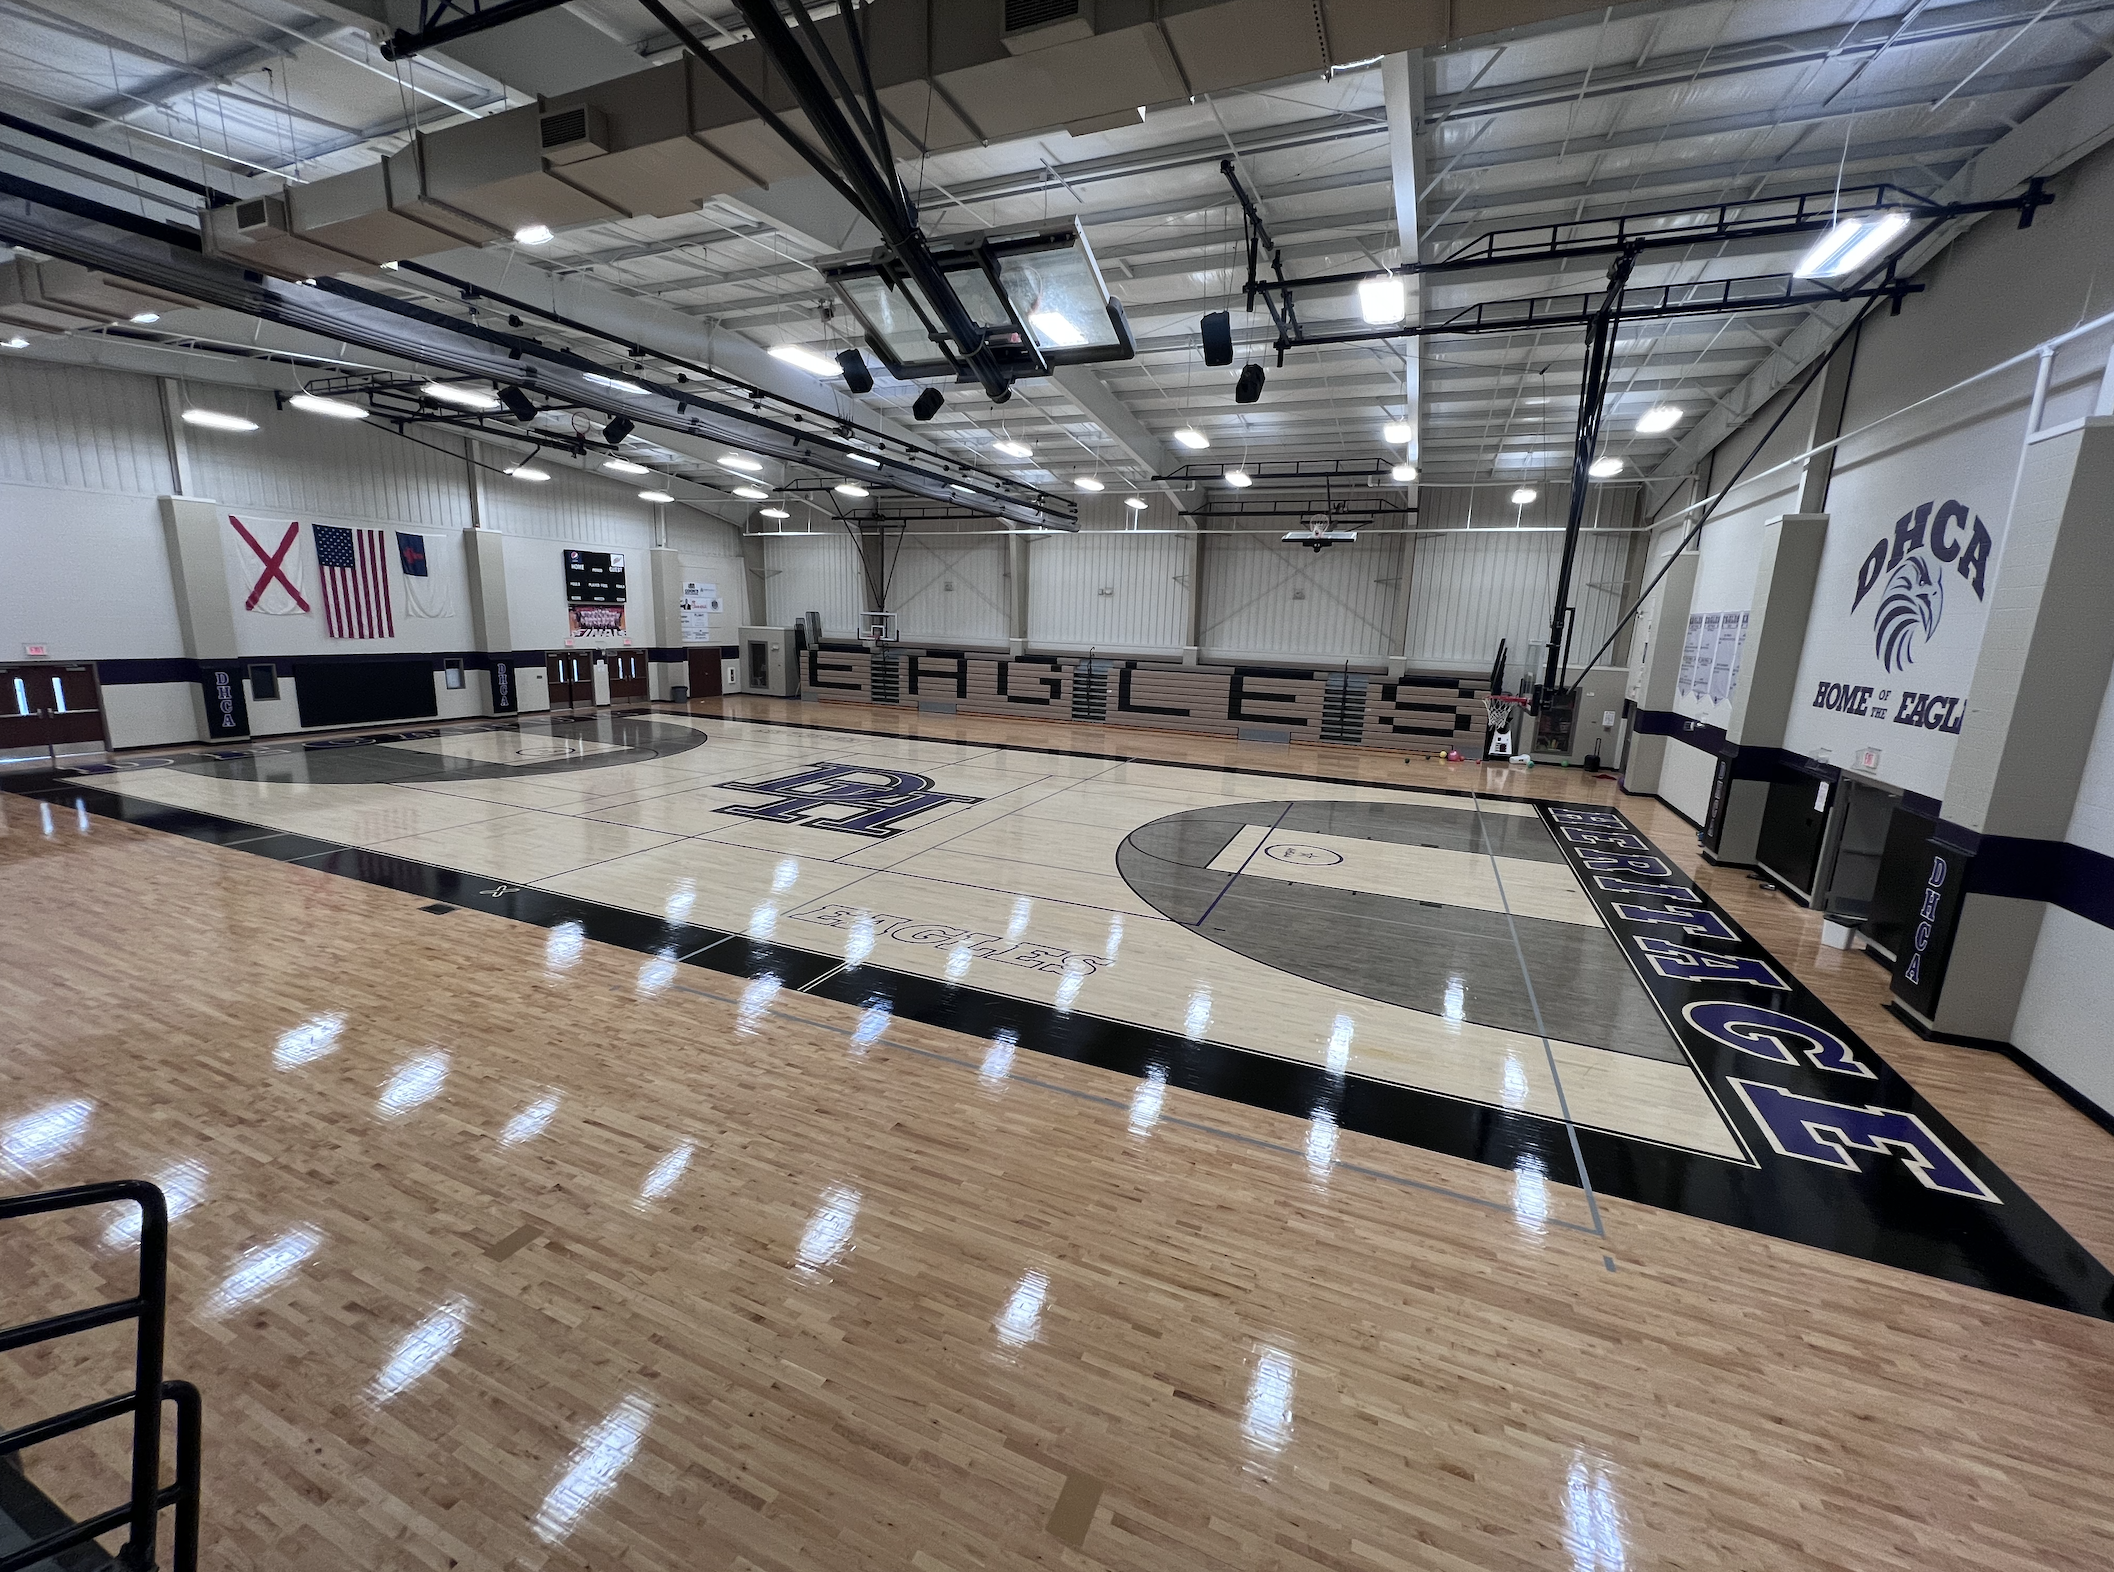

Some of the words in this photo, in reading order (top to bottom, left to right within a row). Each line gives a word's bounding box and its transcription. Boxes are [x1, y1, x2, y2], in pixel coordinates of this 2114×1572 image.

[1851, 499, 1992, 617] DHCA
[215, 671, 237, 728] DHCA
[496, 662, 510, 707] DHCA
[808, 643, 1474, 738] EAGLES
[1812, 681, 1875, 717] HOME
[1870, 706, 1888, 720] THE
[1878, 689, 1892, 701] OF
[1893, 691, 1967, 735] EAGL
[787, 903, 1117, 976] EAGLES
[1905, 855, 1948, 986] DHCA
[1548, 807, 2005, 1205] HERITAGE
